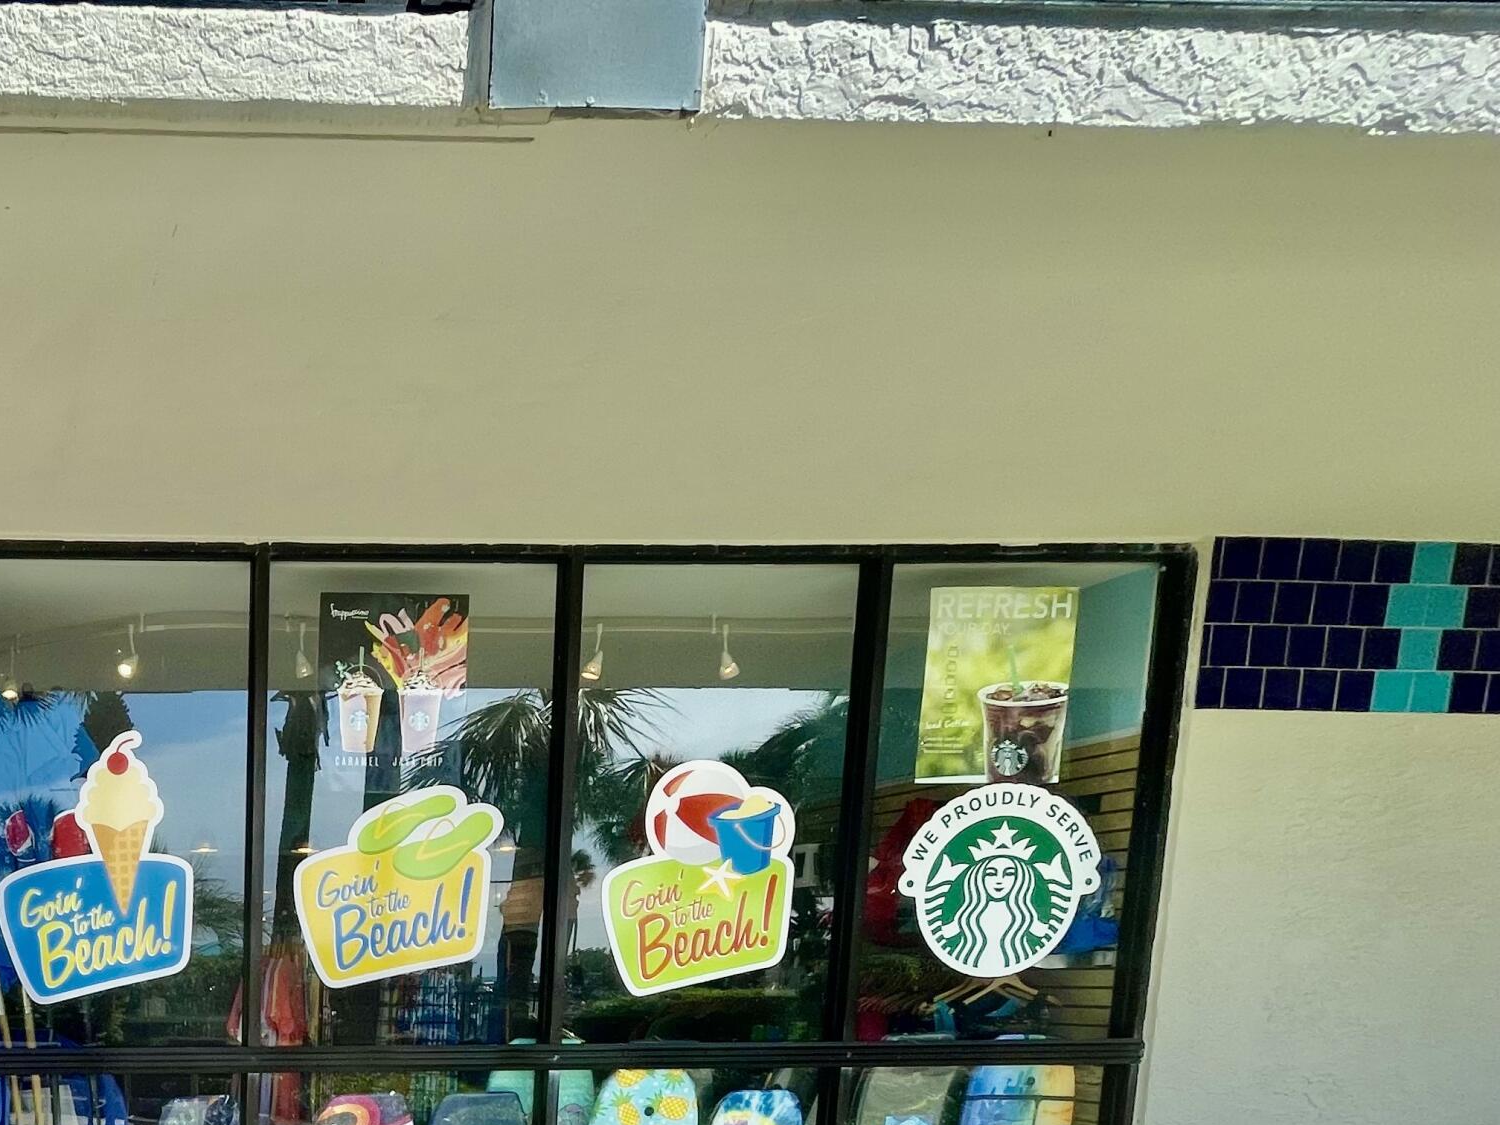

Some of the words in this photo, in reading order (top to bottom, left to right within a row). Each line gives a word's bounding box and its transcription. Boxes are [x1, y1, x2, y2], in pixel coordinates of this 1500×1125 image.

[937, 593, 1073, 619] REFRESH
[335, 755, 379, 767] CARAMEL
[912, 830, 939, 861] WE
[940, 791, 1041, 829] PROUDLY
[1045, 804, 1094, 862] SERVE
[20, 877, 84, 929] Goin'
[317, 860, 380, 908] Goin'
[367, 896, 384, 917] to
[384, 888, 411, 912] the
[621, 868, 684, 918] Goin'
[38, 880, 177, 989] Beach!
[71, 914, 89, 936] to
[88, 902, 115, 930] the
[333, 867, 474, 971] Beach!
[638, 873, 778, 981] Beach!
[671, 905, 688, 927] to
[689, 898, 714, 921] the
